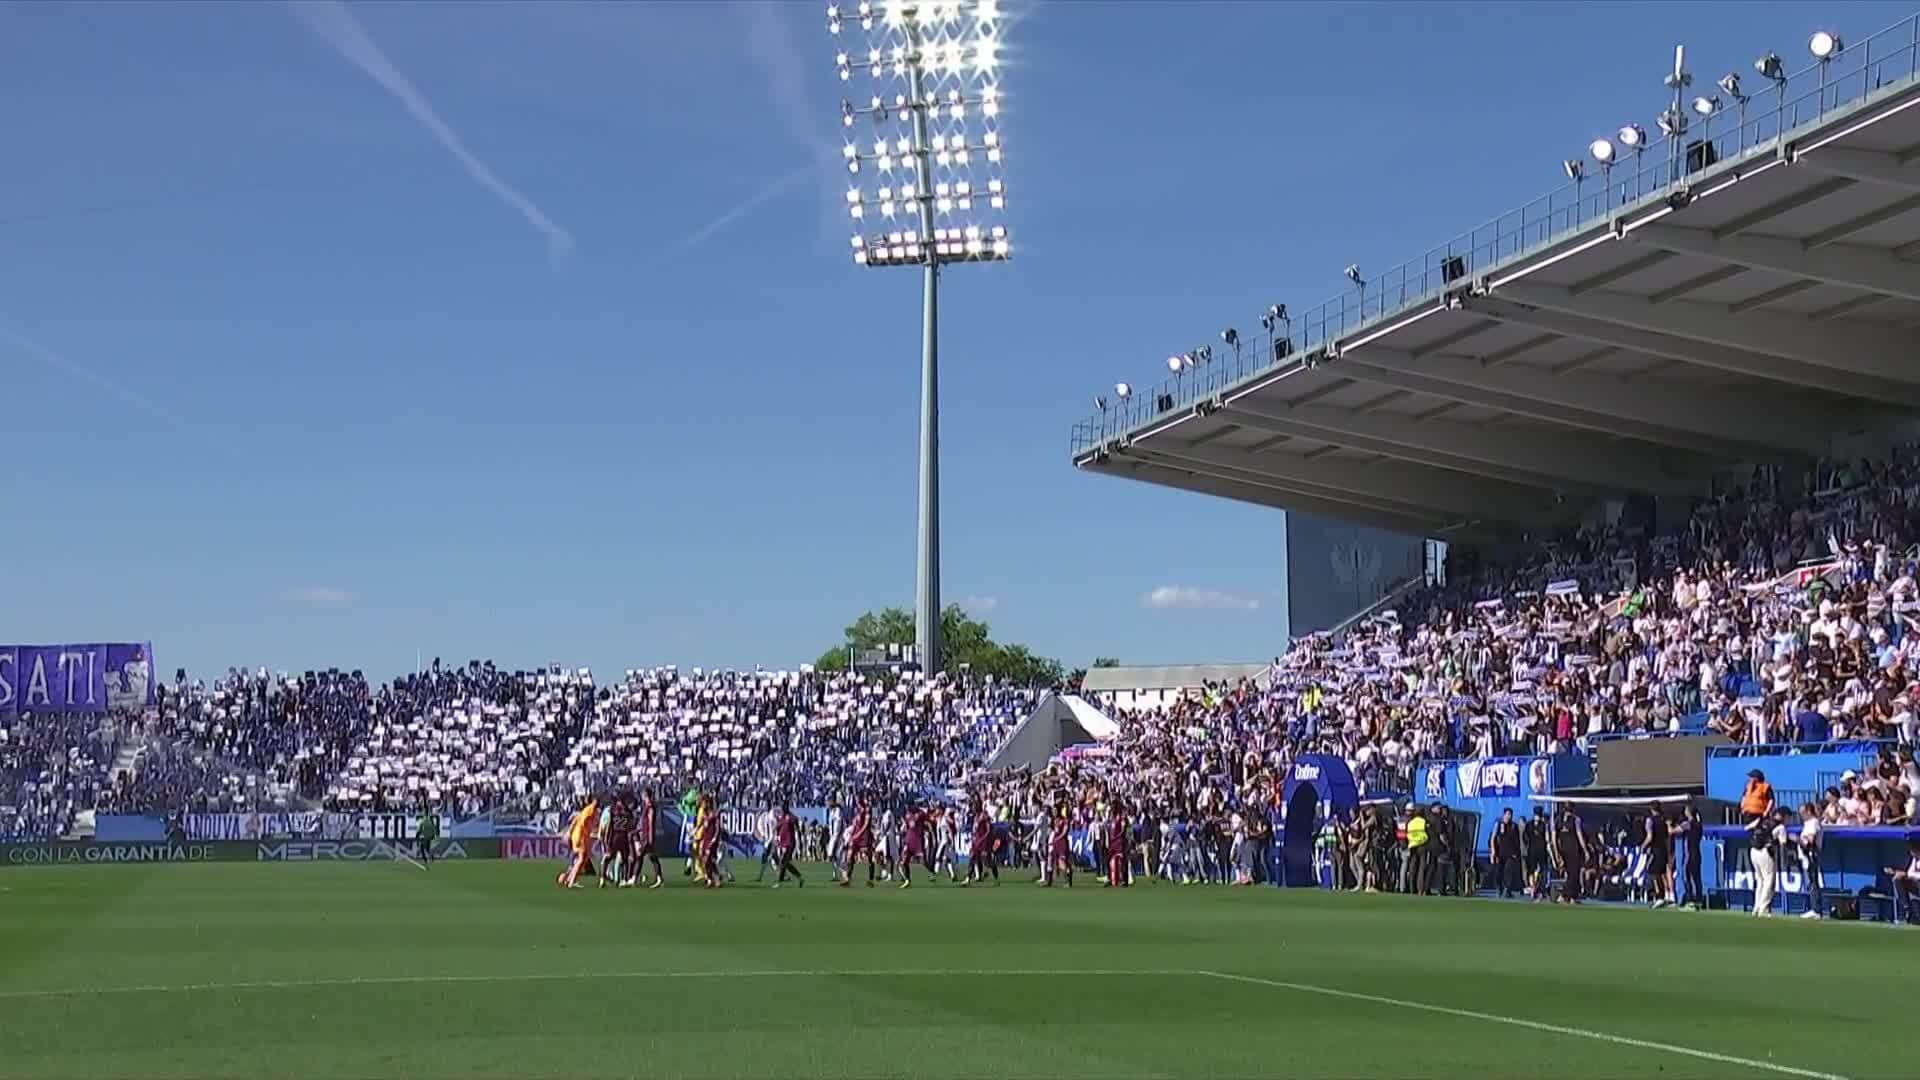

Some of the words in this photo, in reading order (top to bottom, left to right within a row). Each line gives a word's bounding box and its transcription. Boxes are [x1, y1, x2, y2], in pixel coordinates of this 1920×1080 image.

[9, 848, 50, 862] CON
[58, 848, 80, 861] LA
[85, 844, 185, 861] GARANTÍA
[189, 845, 214, 860] DE
